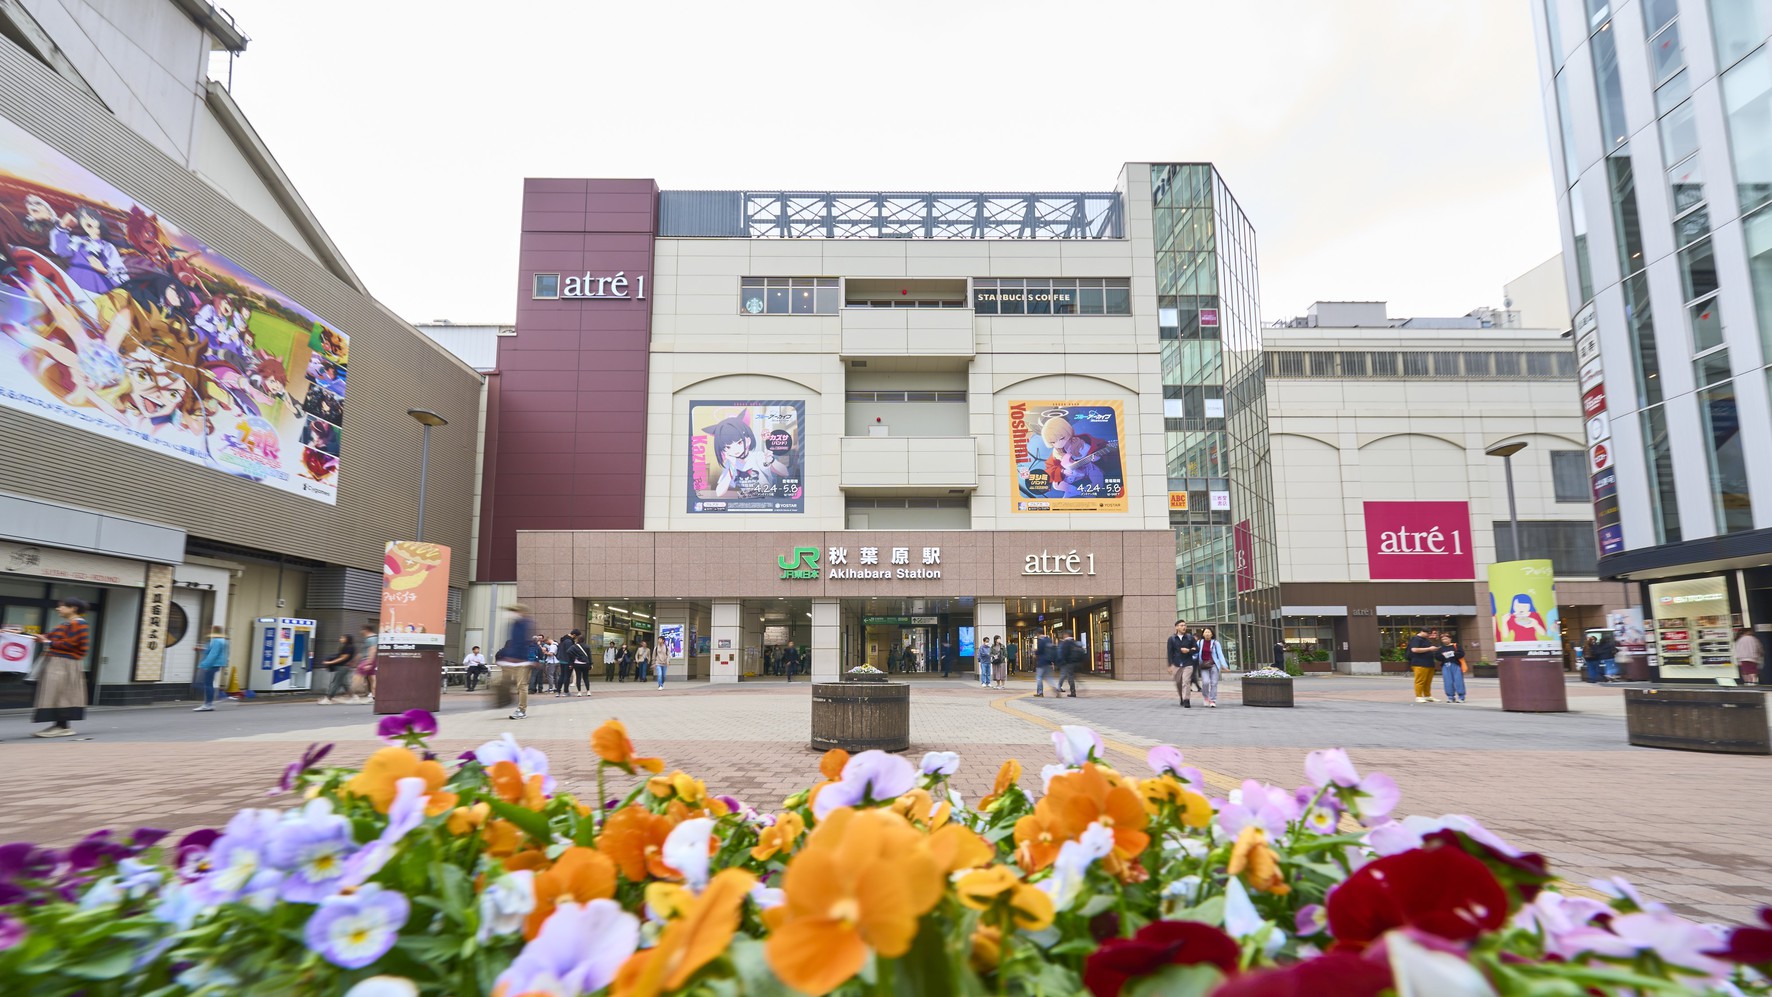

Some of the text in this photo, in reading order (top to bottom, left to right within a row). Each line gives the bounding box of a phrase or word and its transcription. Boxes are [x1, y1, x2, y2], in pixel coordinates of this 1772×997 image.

[563, 271, 646, 298] atré 1
[1010, 403, 1031, 463] Yoshimi
[754, 484, 777, 493] 4.24
[783, 484, 798, 493] 5.8
[1077, 484, 1100, 493] 4.24
[1106, 484, 1121, 493] 5.8
[1380, 525, 1463, 555] atré 1
[778, 547, 820, 570] JR
[829, 547, 941, 565] 秋葉原駅
[1024, 549, 1097, 575] atré 1
[829, 568, 941, 579] Akihabara Station
